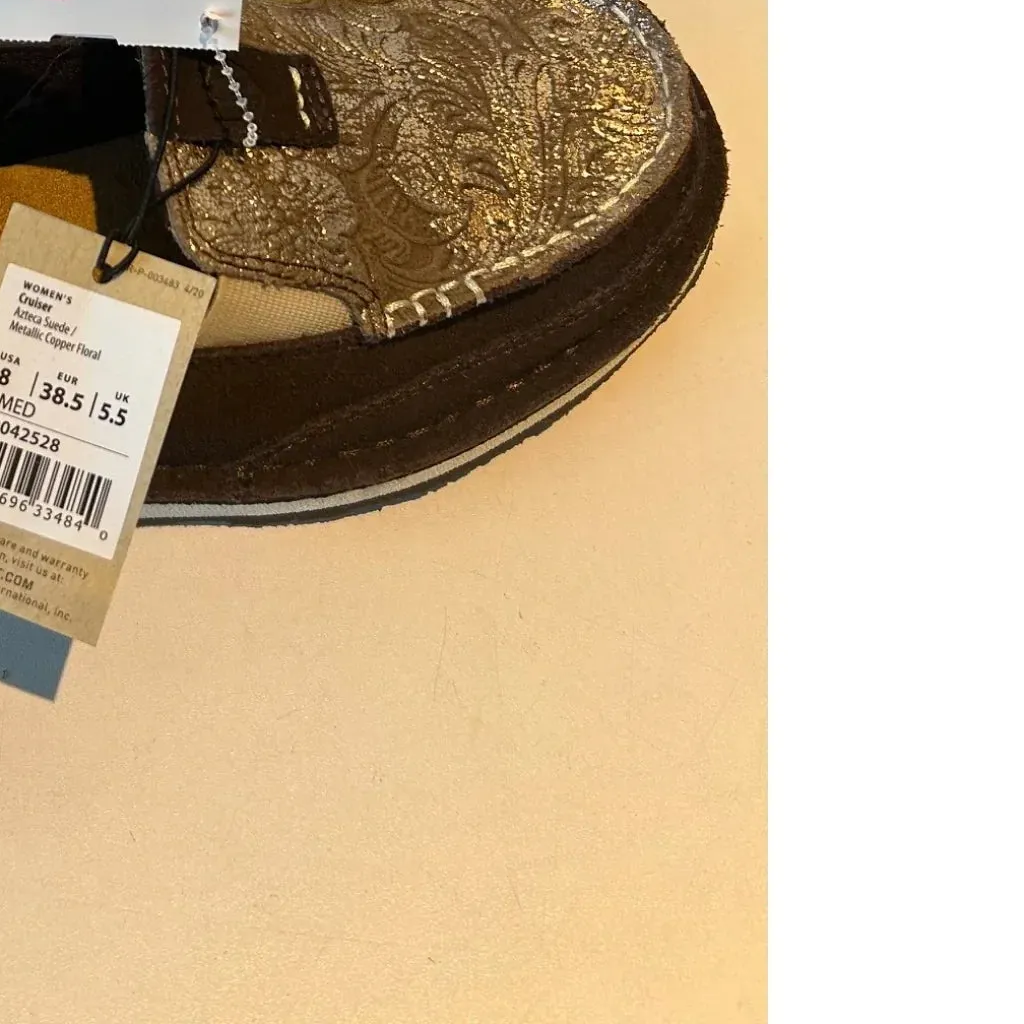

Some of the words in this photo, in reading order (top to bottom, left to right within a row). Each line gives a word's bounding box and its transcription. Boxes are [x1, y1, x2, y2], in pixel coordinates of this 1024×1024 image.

[18, 292, 53, 313] Cruiser
[23, 279, 73, 305] WOMEN'S
[13, 306, 43, 325] Azteca
[43, 315, 70, 335] Suede
[9, 319, 44, 342] Metallic
[44, 331, 77, 351] Copper
[76, 342, 102, 361] Floral
[0, 351, 21, 366] USA
[57, 371, 79, 386] EUR
[38, 381, 85, 412] 38.5
[115, 391, 130, 404] UK
[97, 401, 128, 427] 5.5
[32, 503, 84, 532] 33484
[12, 556, 34, 572] visit
[35, 565, 49, 578] us
[50, 571, 65, 584] at:
[19, 543, 40, 559] and
[41, 553, 89, 581] warranty
